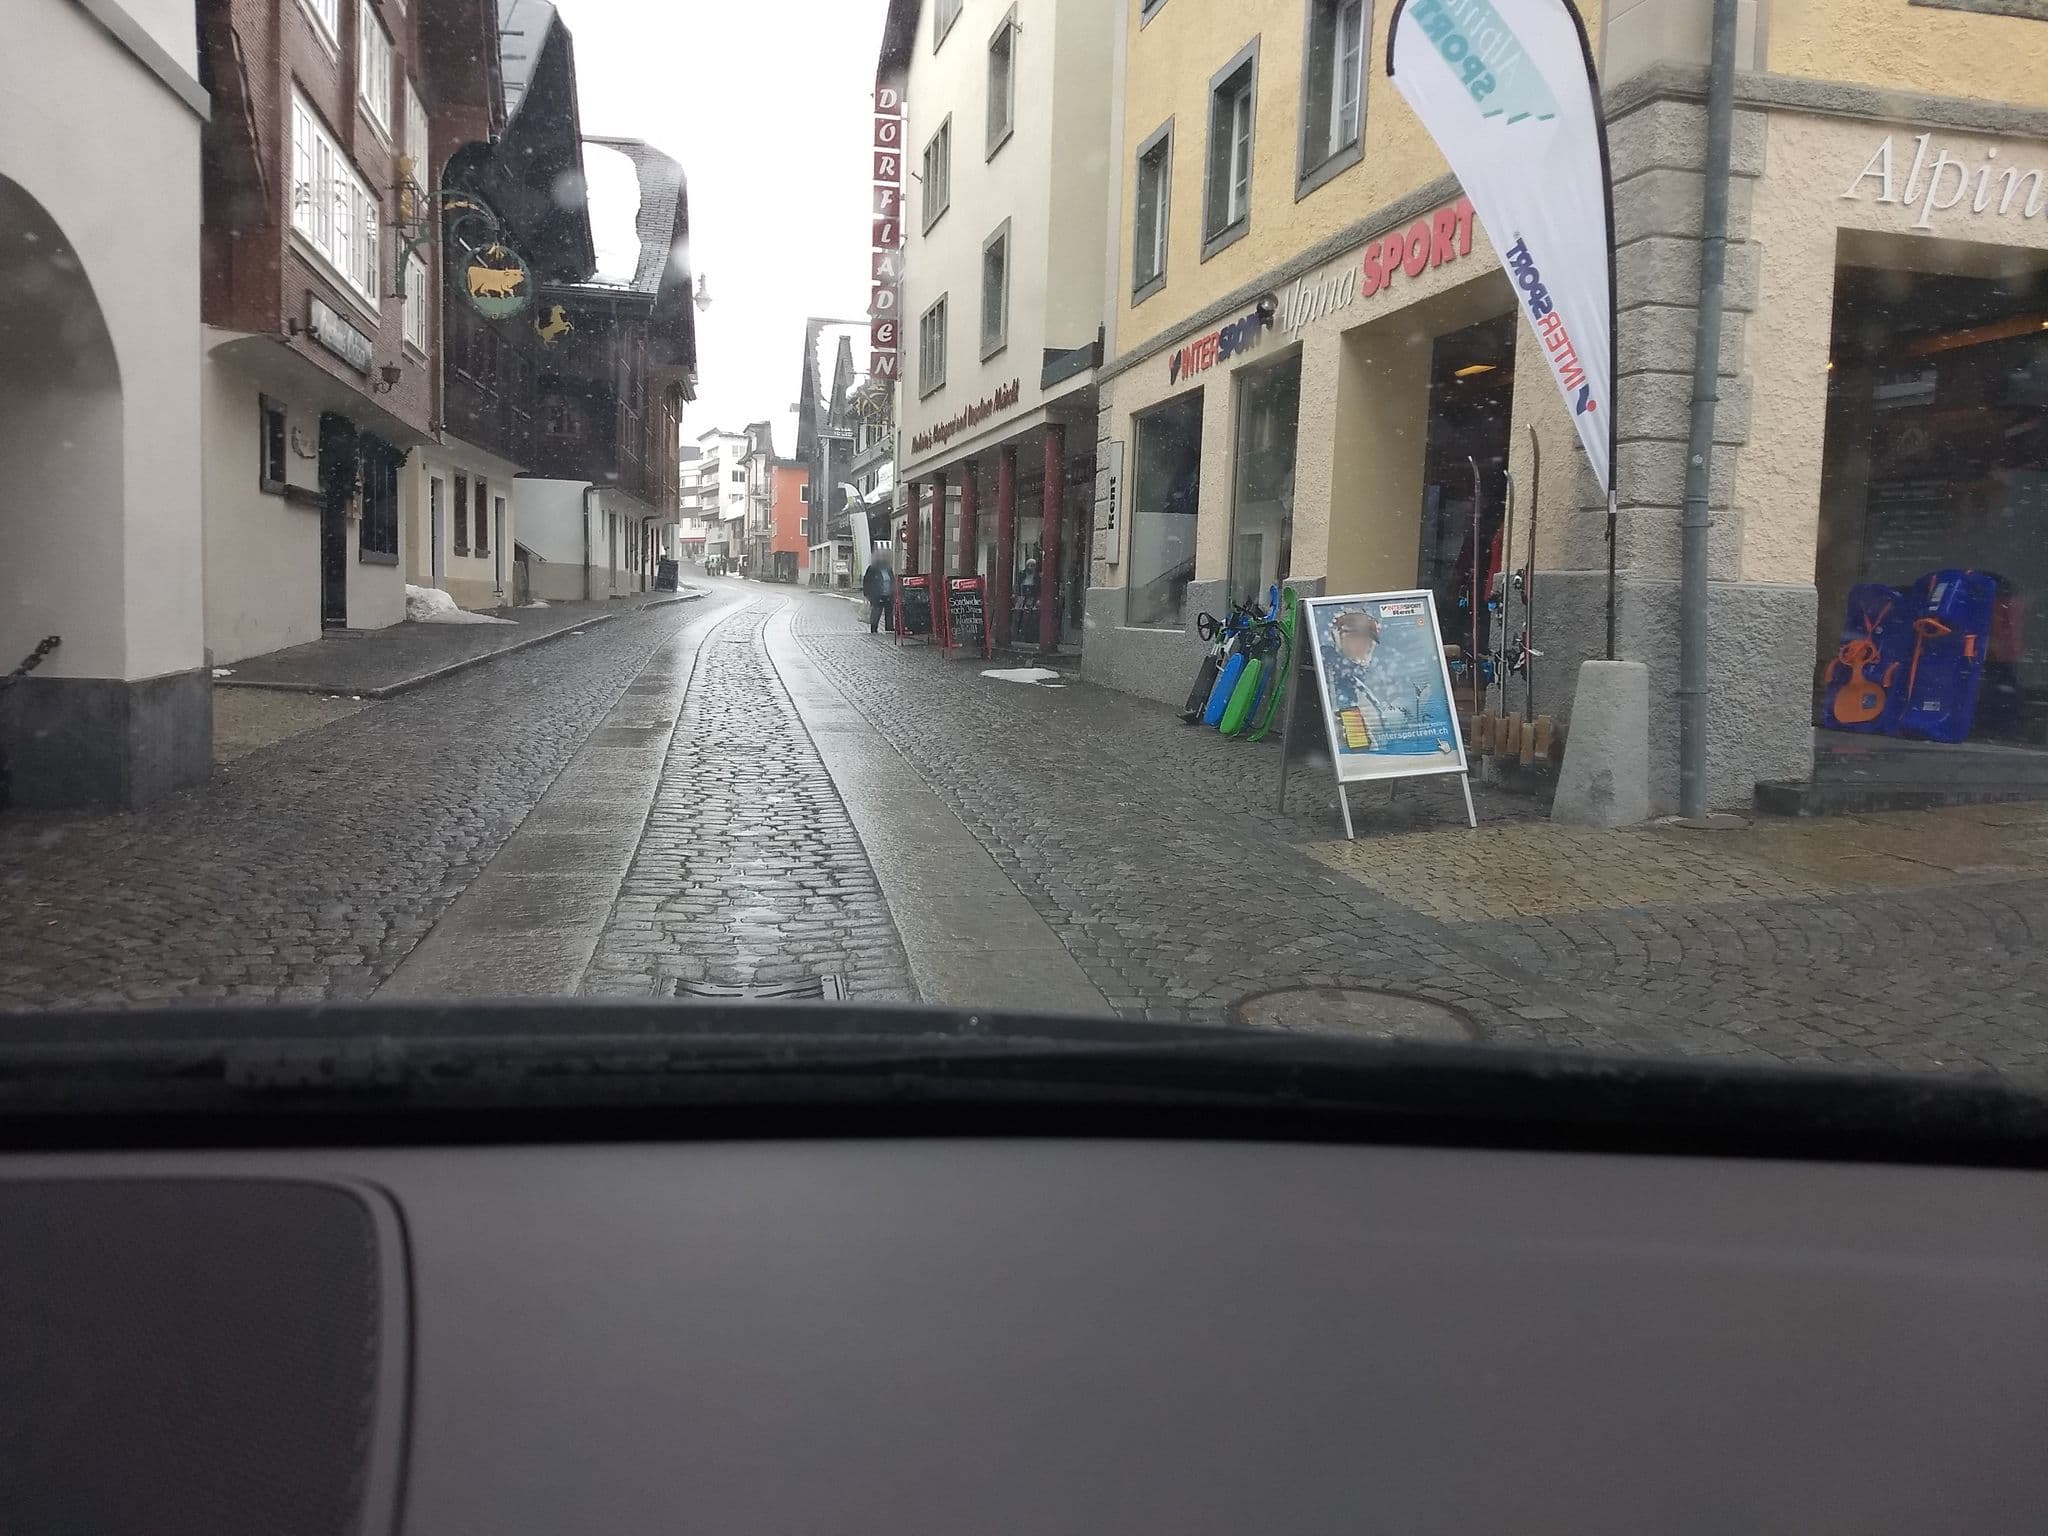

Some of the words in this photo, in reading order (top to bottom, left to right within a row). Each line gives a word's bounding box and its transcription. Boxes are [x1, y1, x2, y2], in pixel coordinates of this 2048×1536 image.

[1839, 132, 2048, 229] Alpin
[1361, 195, 1474, 298] SPORT
[1108, 476, 1117, 530] Rent
[1392, 608, 1416, 616] Rent
[1378, 726, 1449, 741] intersportrent.ch
